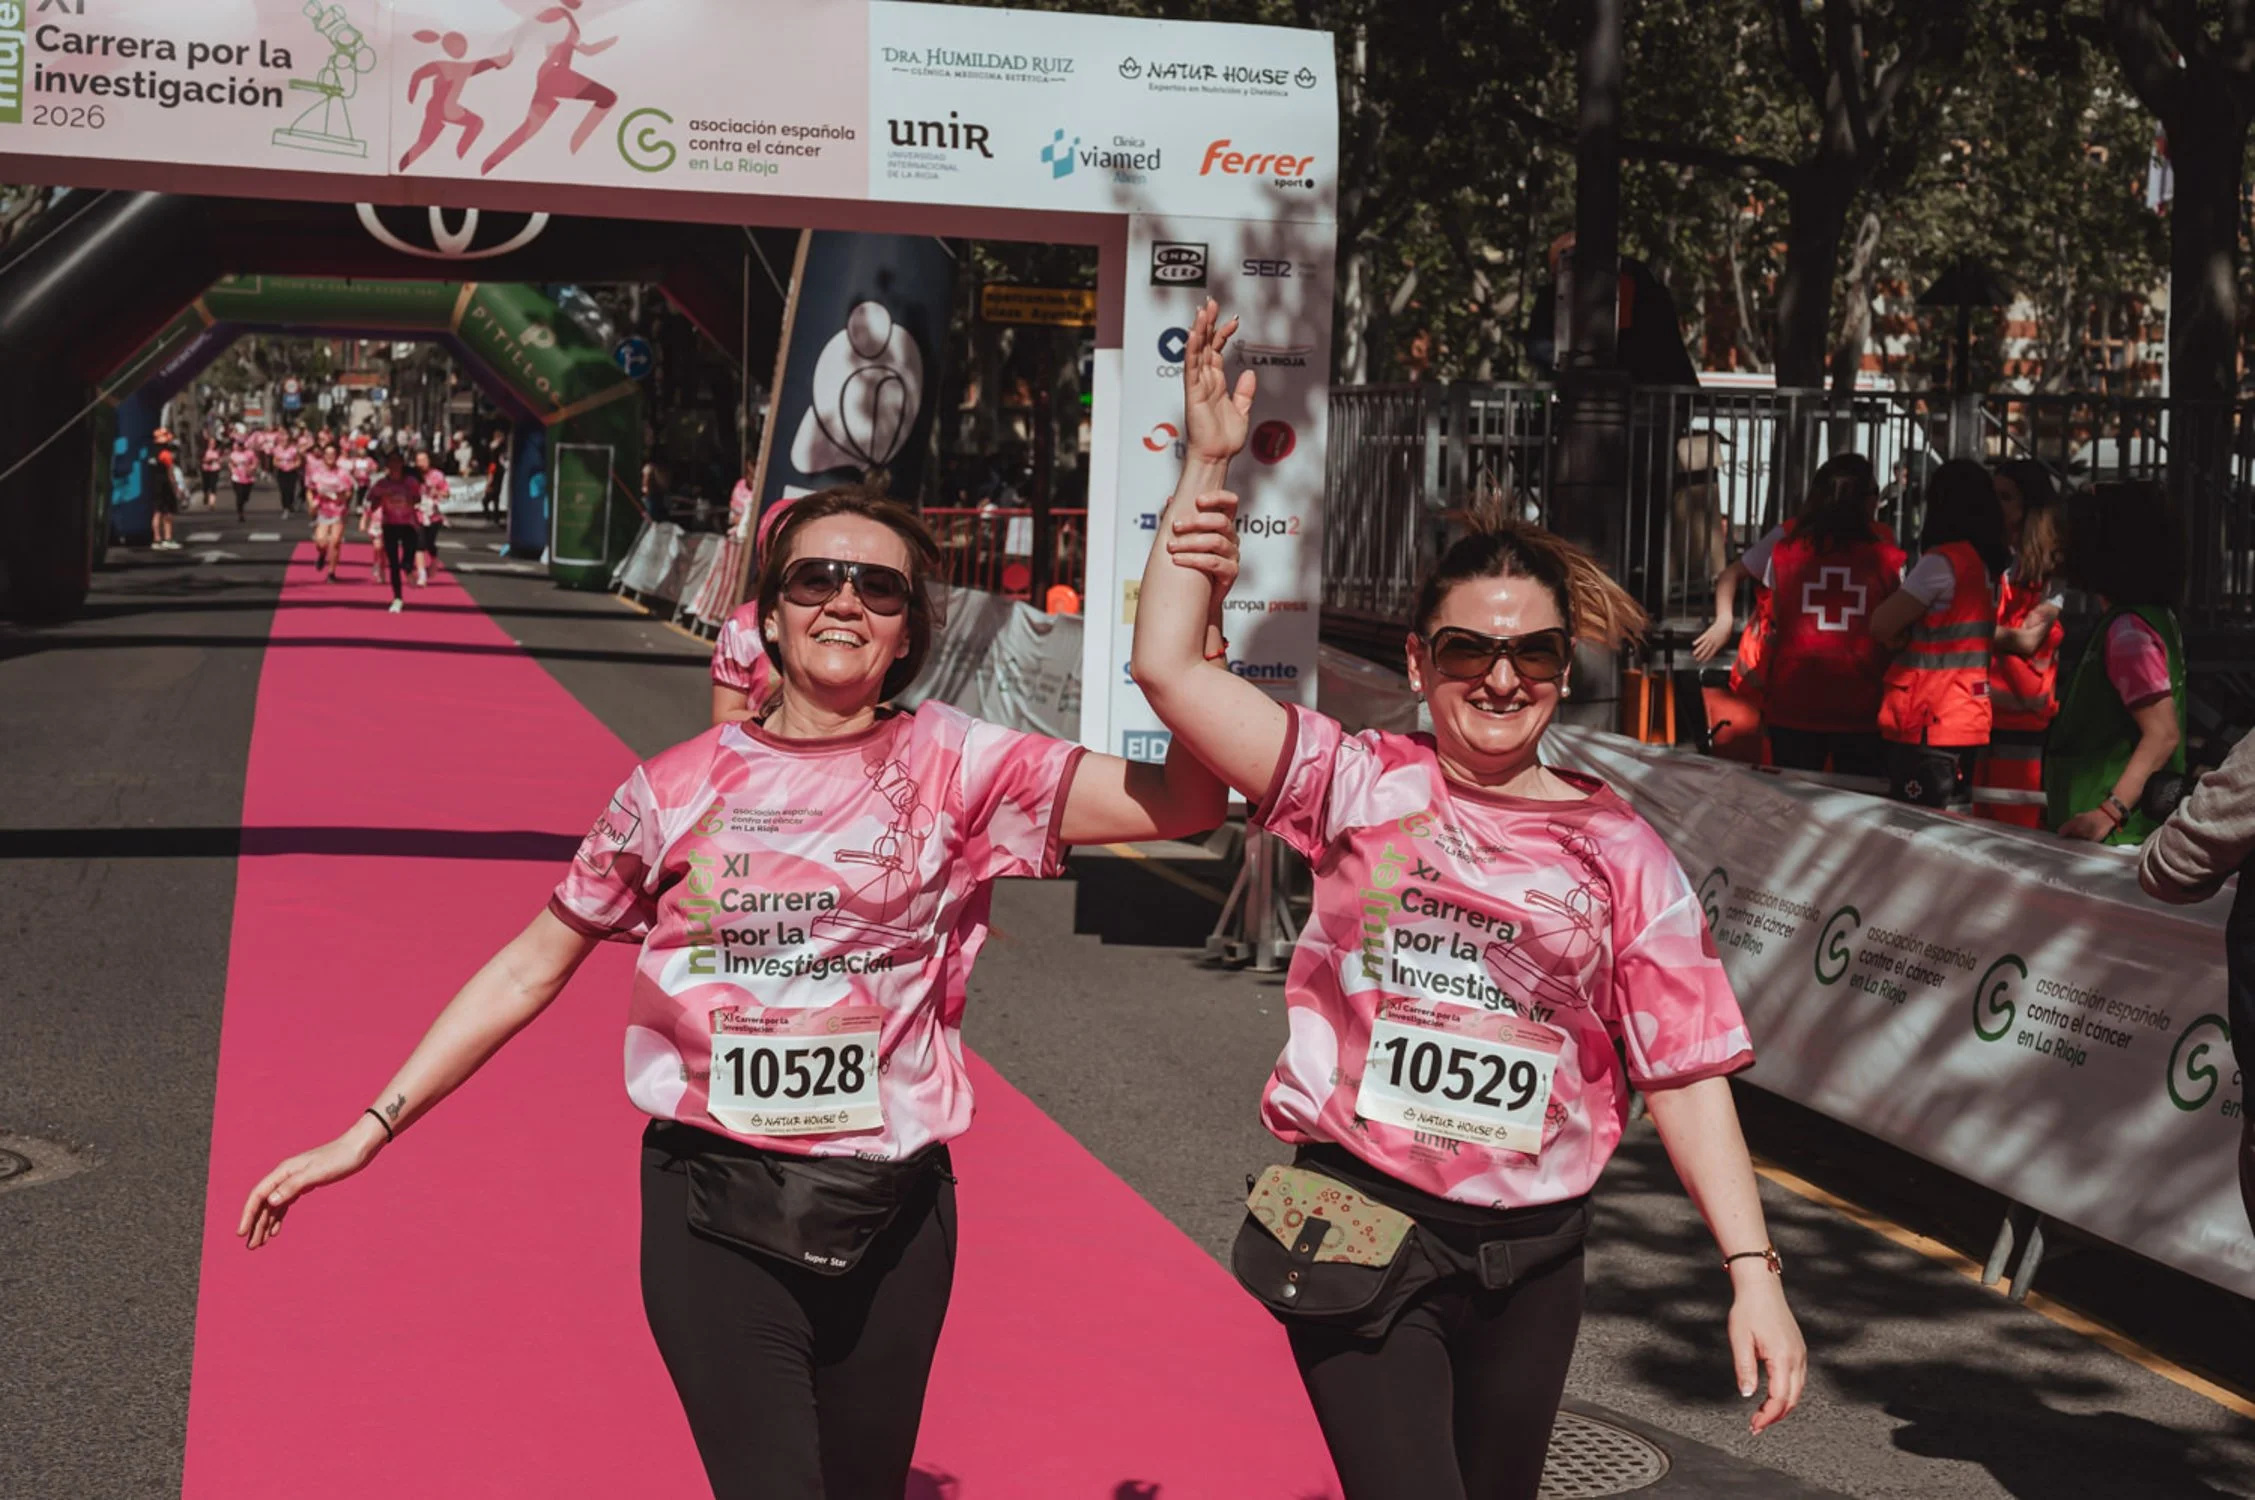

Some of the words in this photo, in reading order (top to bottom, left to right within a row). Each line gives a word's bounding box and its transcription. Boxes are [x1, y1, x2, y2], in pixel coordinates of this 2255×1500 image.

[35, 24, 177, 61] Carrera
[187, 41, 250, 69] por
[259, 40, 293, 69] la
[926, 48, 1028, 69] HUMILDAD
[1032, 56, 1075, 74] RUIZ
[1147, 61, 1218, 81] NATUR
[1222, 65, 1290, 86] HOUSE
[34, 63, 284, 108] investigación
[32, 104, 106, 130] 2026
[689, 117, 777, 136] asociación
[781, 124, 856, 141] española
[688, 137, 743, 153] contra
[746, 140, 762, 153] el
[763, 141, 822, 158] cáncer
[887, 151, 947, 161] UNIVERSIDAD
[1079, 146, 1161, 171] viamed
[1199, 139, 1315, 177] ferrer
[688, 158, 710, 171] en
[713, 158, 734, 172] La
[738, 159, 779, 177] Rioja
[886, 160, 960, 172] INTERNACIONAL
[900, 171, 912, 179] LA
[1274, 178, 1304, 189] sport
[1160, 252, 1198, 261] ONDA
[1242, 259, 1292, 277] SER
[1162, 267, 1198, 278] CERO
[1156, 365, 1184, 378] COP
[1252, 356, 1269, 367] LA
[1270, 356, 1307, 368] RIOJA
[1236, 515, 1301, 539] rioja2
[1223, 600, 1264, 613] uropa
[1269, 601, 1308, 614] press
[1228, 659, 1299, 679] Gente
[721, 853, 750, 879] XI
[1409, 858, 1442, 882] XI
[678, 849, 721, 976] mujer
[720, 887, 835, 913] Carrera
[1360, 844, 1408, 982] mujer
[1733, 885, 1778, 911] asociación
[1778, 897, 1822, 924] española
[1400, 887, 1516, 944] Carrera
[1725, 904, 1754, 924] contra
[1753, 909, 1763, 929] el
[1763, 913, 1796, 939] cáncer
[720, 925, 770, 949] por
[776, 920, 806, 946] la
[1393, 928, 1445, 955] por
[1451, 932, 1478, 962] la
[1718, 927, 1729, 942] en
[1729, 929, 1741, 949] La
[1741, 932, 1764, 959] Rioja
[1867, 924, 1924, 955] asociación
[1924, 942, 1978, 973] española
[723, 950, 895, 981] Investigación
[1858, 948, 1893, 972] contra
[1894, 955, 1906, 976] el
[1905, 959, 1947, 989] cáncer
[1850, 972, 1864, 988] en
[1864, 973, 1878, 995] La
[1878, 977, 1908, 1007] Rioja
[1403, 1005, 1436, 1017] Carrera
[2035, 976, 2106, 1012] asociación
[2107, 998, 2172, 1032] española
[2026, 1001, 2070, 1031] contra
[2070, 1012, 2085, 1036] el
[2085, 1018, 2133, 1051] cáncer
[2016, 1028, 2034, 1048] en
[2034, 1030, 2053, 1056] La
[2053, 1036, 2088, 1069] Rioja
[724, 1044, 866, 1099] 10528
[1385, 1036, 1538, 1112] 10529
[764, 1116, 801, 1127] NATUR
[803, 1114, 837, 1125] HOUSE
[2220, 1097, 2242, 1119] en
[1456, 1120, 1494, 1137] HOUSE
[804, 1251, 829, 1265] Super
[830, 1255, 848, 1268] Star
